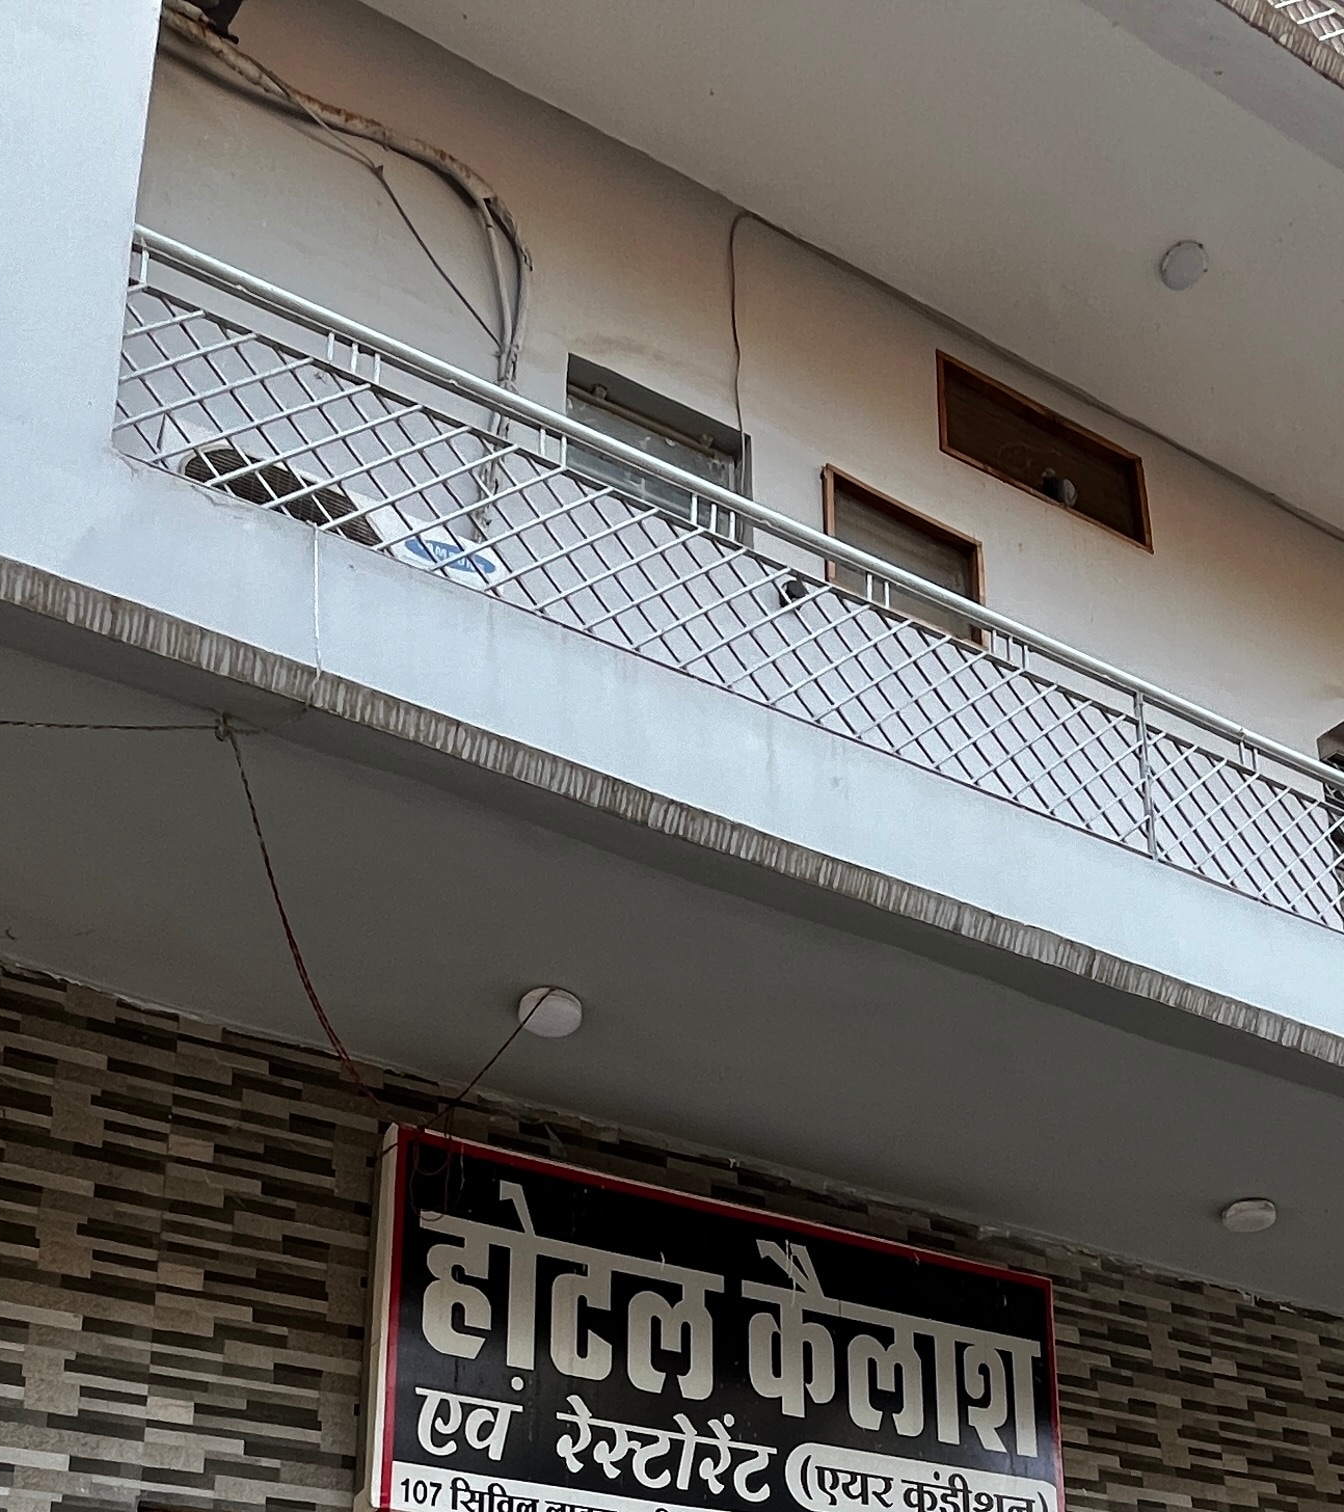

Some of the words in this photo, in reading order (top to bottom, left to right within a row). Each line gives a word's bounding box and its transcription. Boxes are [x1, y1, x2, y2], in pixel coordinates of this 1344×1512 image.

[419, 1181, 725, 1401] होटल
[740, 1238, 1042, 1458] कैलाश
[400, 1477, 443, 1507] 107
[414, 1375, 524, 1462] एवं
[556, 1393, 778, 1503] रेस्टोरेंट
[800, 1453, 894, 1509] (एयर
